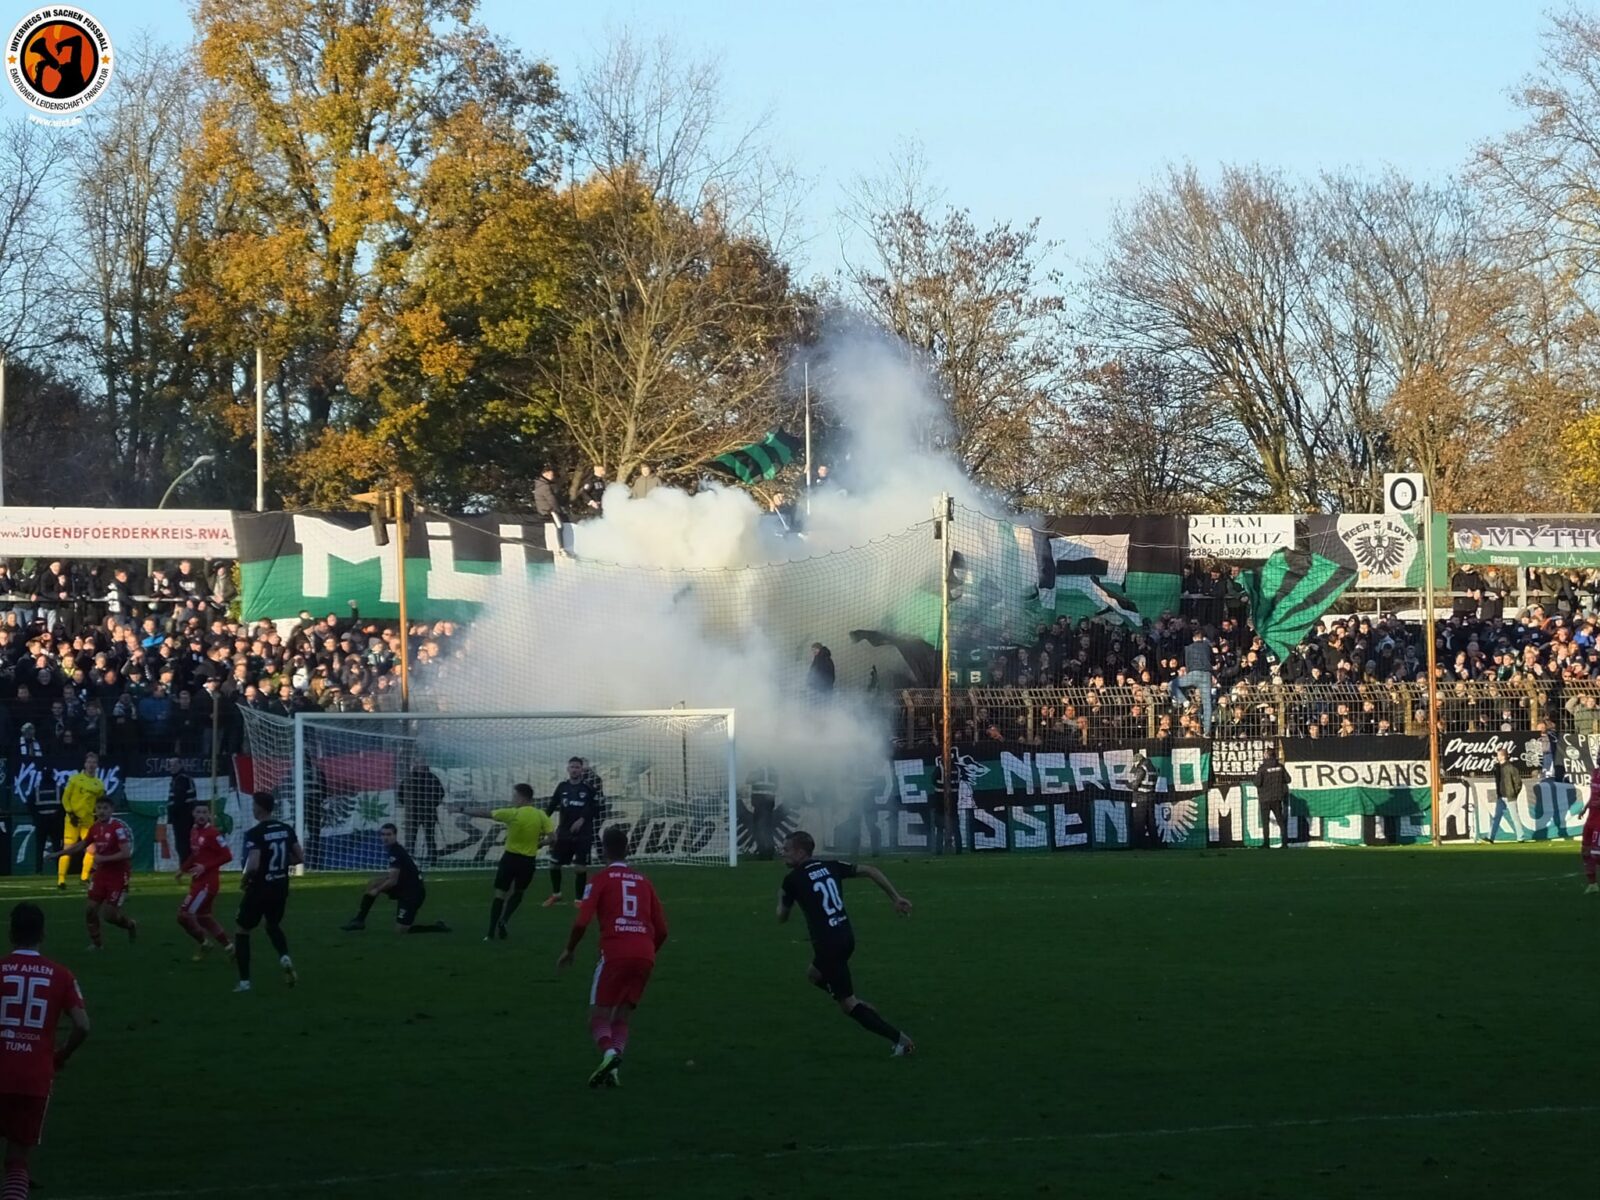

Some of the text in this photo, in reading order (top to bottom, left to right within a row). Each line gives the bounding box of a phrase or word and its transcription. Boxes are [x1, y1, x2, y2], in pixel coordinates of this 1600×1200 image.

[1486, 524, 1600, 548] MYTH
[1445, 736, 1517, 756] Preußen
[1294, 764, 1428, 788] TROJANS
[1563, 757, 1587, 773] FAN
[269, 840, 287, 871] 21
[621, 880, 638, 917] 6
[813, 877, 844, 916] 20
[1, 964, 54, 976] RW AHLEN
[0, 974, 51, 1029] 26
[5, 1041, 33, 1053] TUMA
